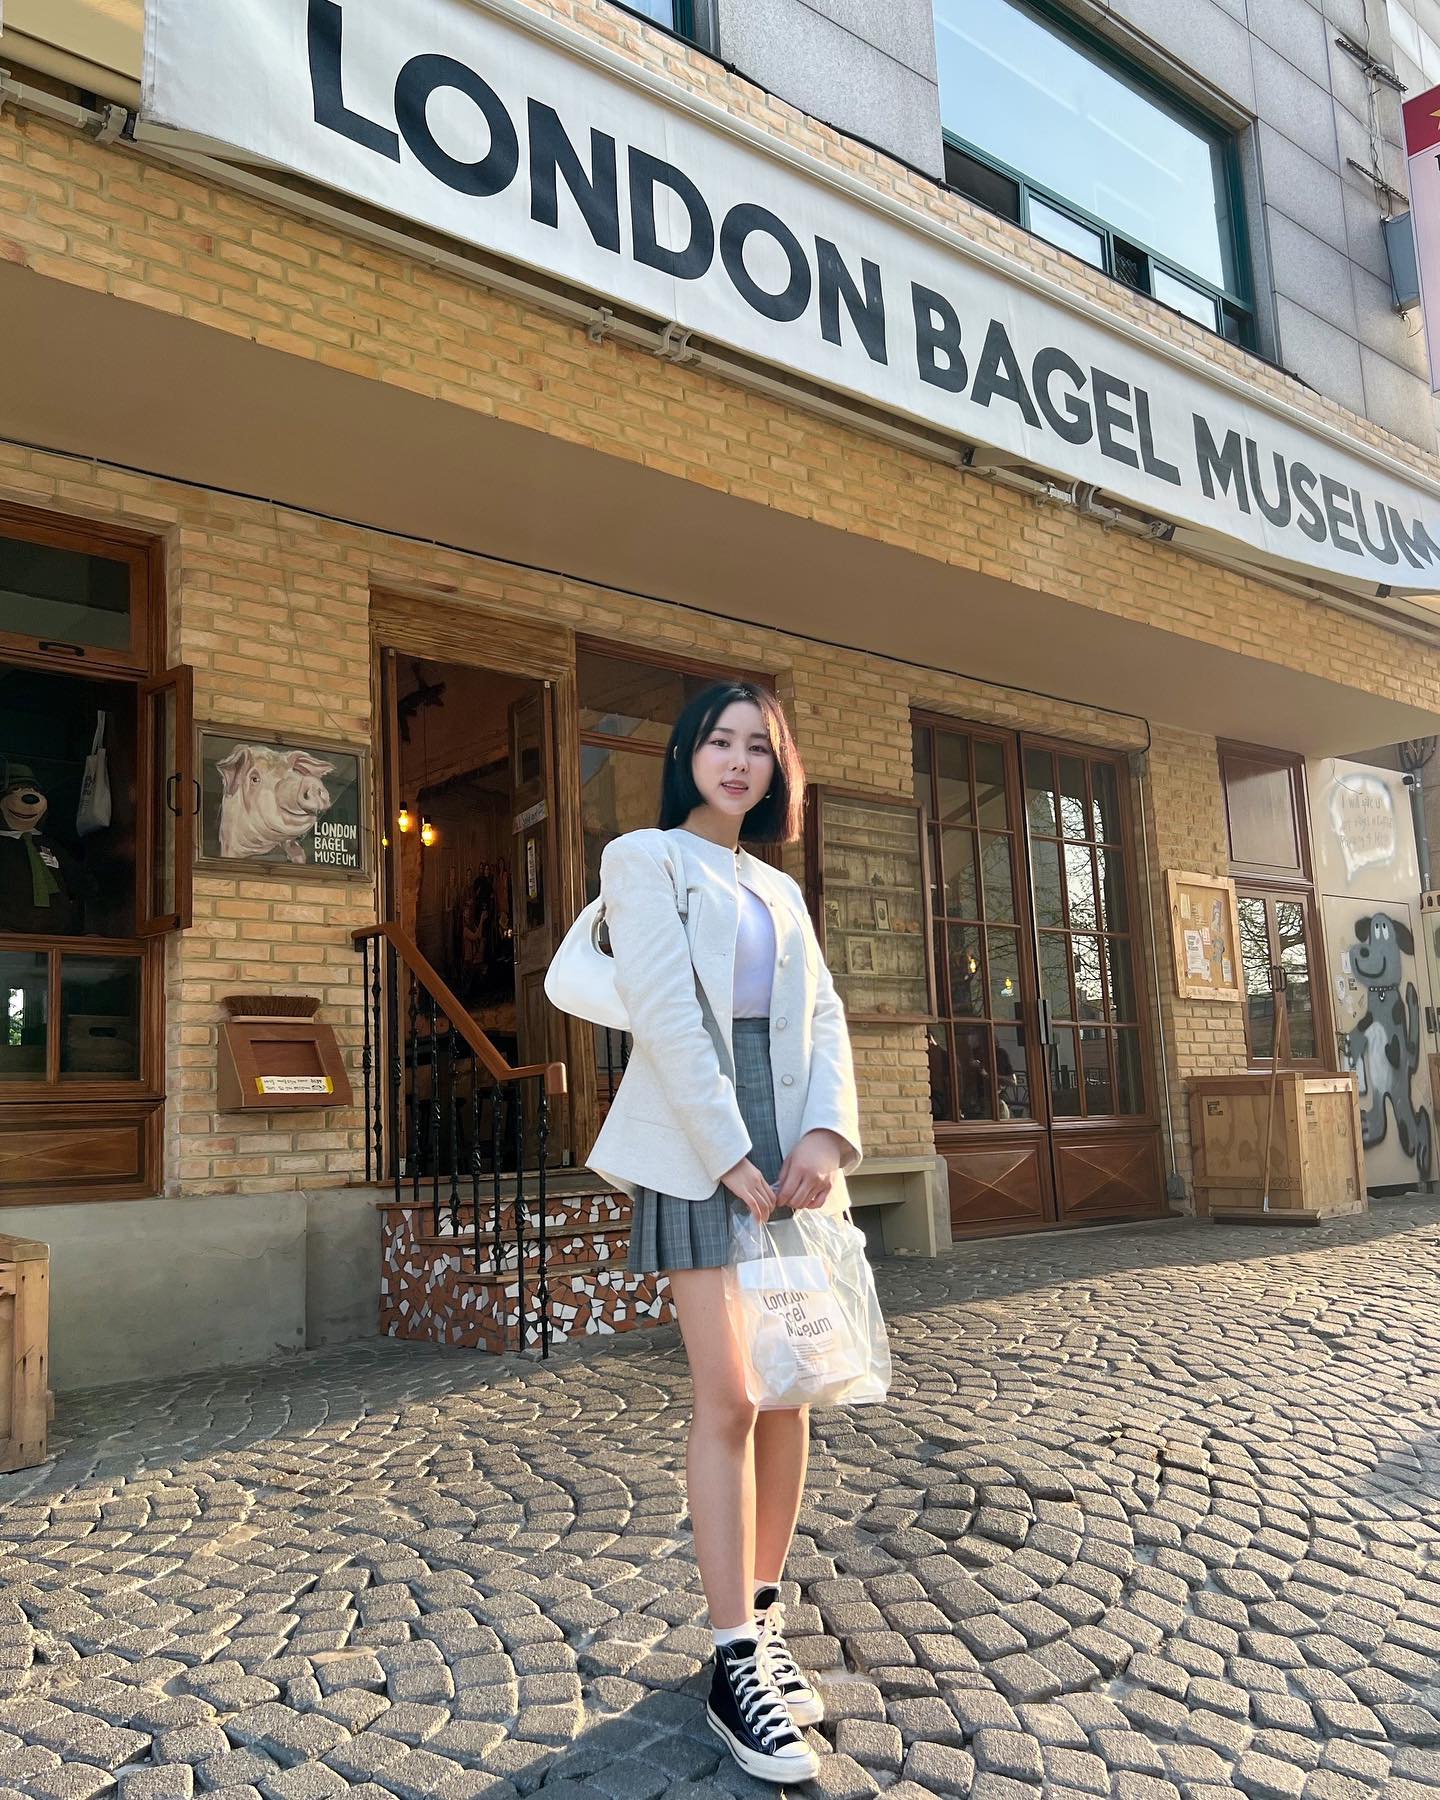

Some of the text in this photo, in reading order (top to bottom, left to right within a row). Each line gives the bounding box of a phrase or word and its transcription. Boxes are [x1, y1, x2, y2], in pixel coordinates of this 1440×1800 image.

[307, 0, 1440, 569] LONDON BAGEL MUSEUM
[314, 821, 357, 840] LONDON
[314, 836, 348, 852] BAGEL
[314, 851, 356, 867] MUSEUM
